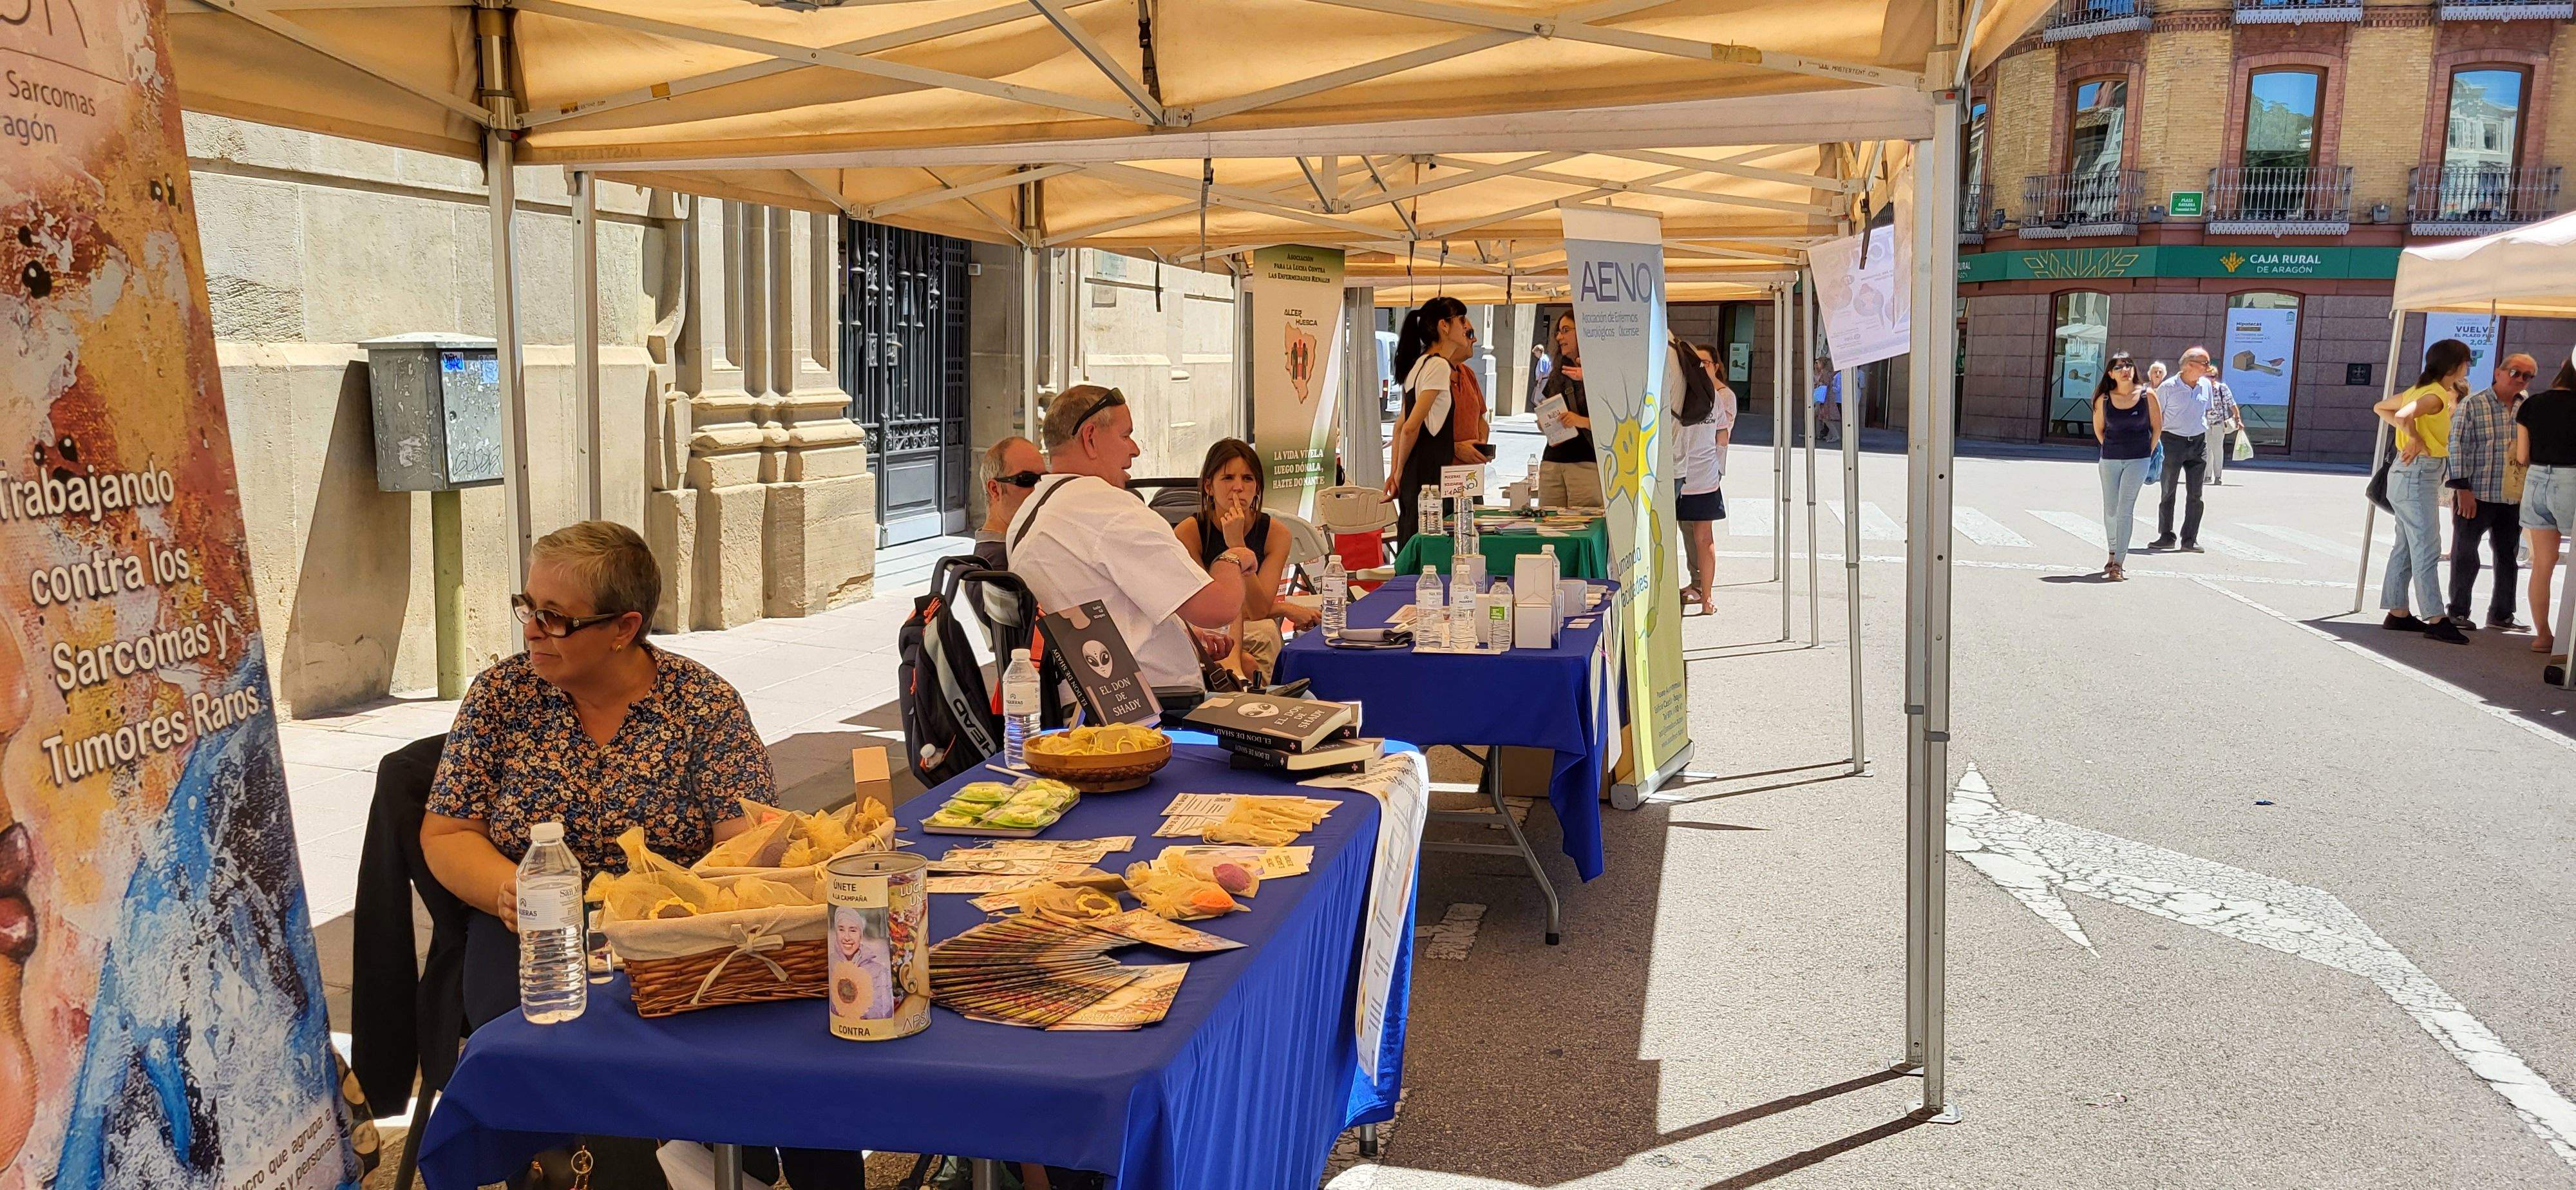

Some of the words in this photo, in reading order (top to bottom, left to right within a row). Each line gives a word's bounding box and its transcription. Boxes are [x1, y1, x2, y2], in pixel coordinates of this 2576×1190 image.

[6, 70, 96, 117] Sarcomas
[2249, 254, 2279, 264] CAJA
[2282, 254, 2322, 264] RURAL
[1308, 265, 1325, 274] CONTRA
[2271, 265, 2313, 274] ARAGÓN
[1277, 272, 1311, 282] ENFERMEDADES
[1580, 261, 1653, 303] AENO
[1284, 308, 1302, 317] ALCER
[1274, 451, 1282, 460] LA
[1283, 450, 1299, 460] VIDA
[1300, 448, 1324, 458] VÍVELA
[1274, 464, 1294, 475] LUEGO
[1273, 478, 1293, 489] HAZTE
[1293, 476, 1325, 487] DONANTE
[1452, 482, 1475, 495] AENO
[0, 460, 175, 523] Trabajando
[31, 550, 146, 607] contra
[149, 540, 191, 585] los
[52, 624, 211, 691] Sarcomas
[211, 616, 227, 661] y
[1052, 648, 1068, 671] SHADY
[1065, 670, 1074, 681] DE
[1070, 681, 1083, 699] DON
[1099, 685, 1112, 696] EL
[1110, 677, 1132, 692] DON
[1080, 698, 1088, 707] EL
[1115, 691, 1128, 703] DE
[1112, 698, 1142, 717] SHADY
[1274, 717, 1289, 726] EL
[1284, 704, 1304, 717] DON
[1293, 712, 1307, 721] DE
[1298, 709, 1325, 729] SHADY
[953, 698, 996, 758] HEAD
[1213, 728, 1235, 738] SHADY
[43, 710, 188, 786] Tumores
[191, 685, 260, 736] Raros
[1247, 734, 1262, 742] DON
[1254, 750, 1264, 759] DON
[833, 878, 857, 892] ÚNETE
[559, 888, 573, 898] San
[840, 893, 868, 902] CAMPAÑA
[838, 1025, 871, 1037] CONTRA
[269, 1149, 289, 1176] que
[291, 1116, 323, 1154] agrupa
[325, 1108, 331, 1122] a
[295, 1133, 336, 1185] personas
